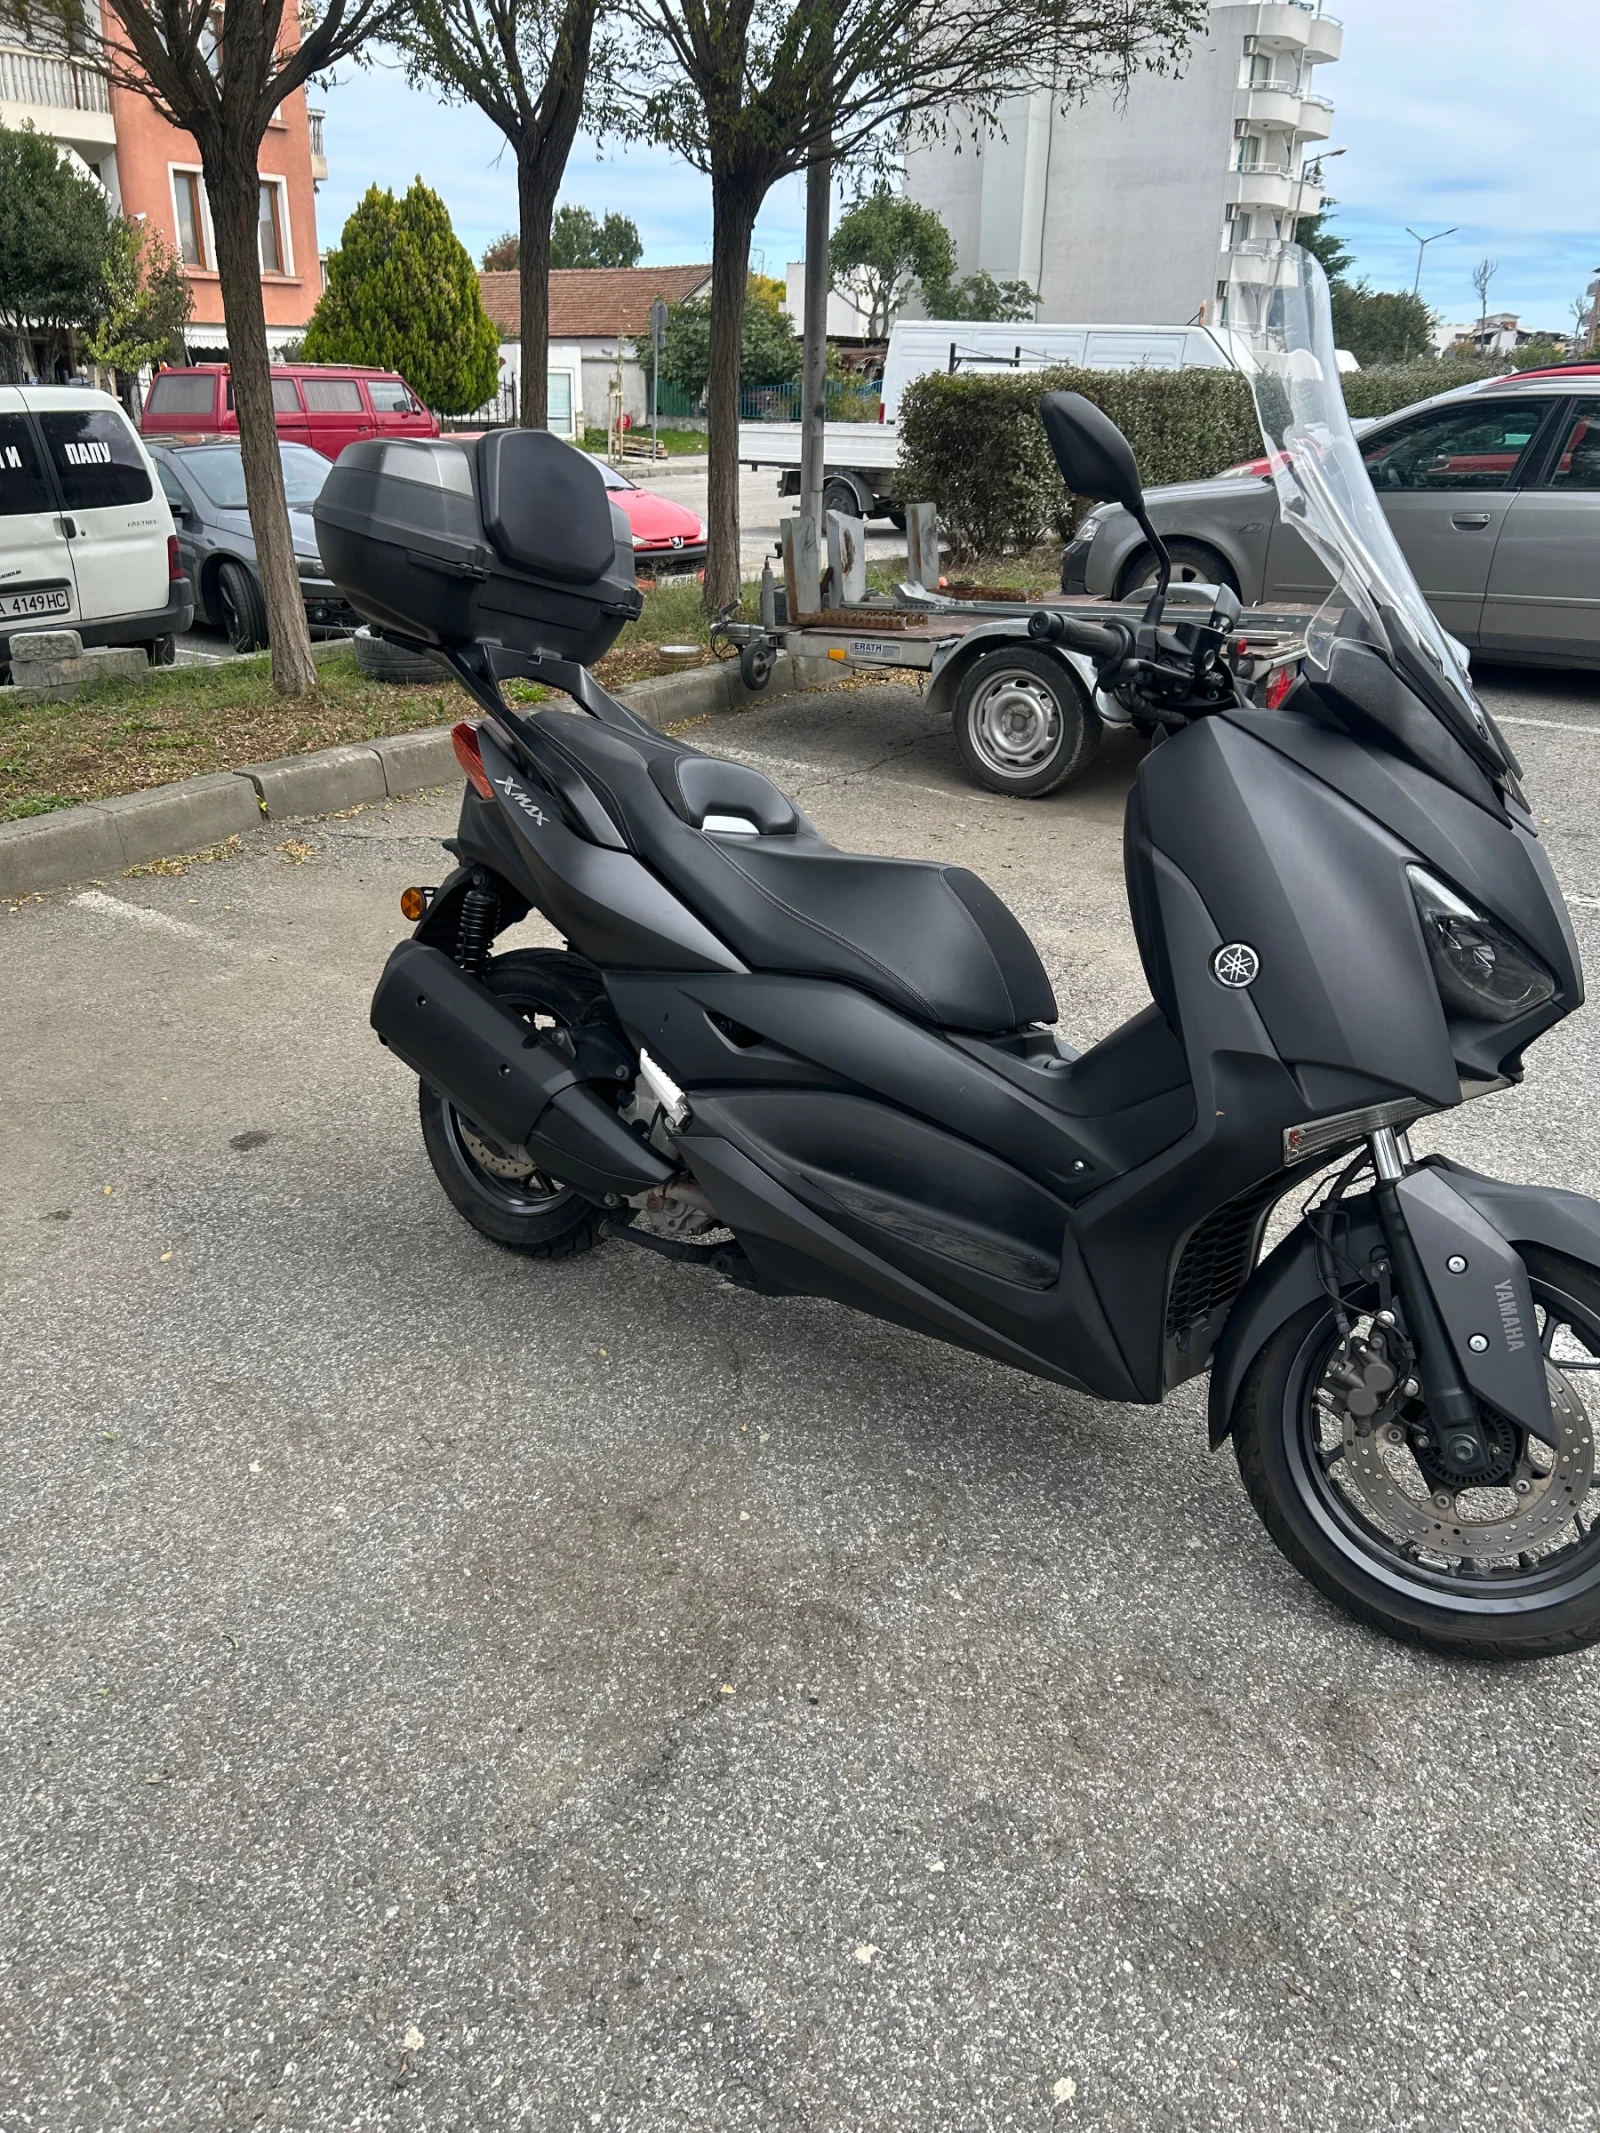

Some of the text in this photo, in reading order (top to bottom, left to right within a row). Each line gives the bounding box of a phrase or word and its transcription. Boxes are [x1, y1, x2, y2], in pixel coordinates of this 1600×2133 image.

[5, 446, 22, 468] И
[64, 442, 111, 465] ПАПУ
[854, 642, 882, 653] ERATH
[1494, 1279, 1526, 1352] YAMAHA
